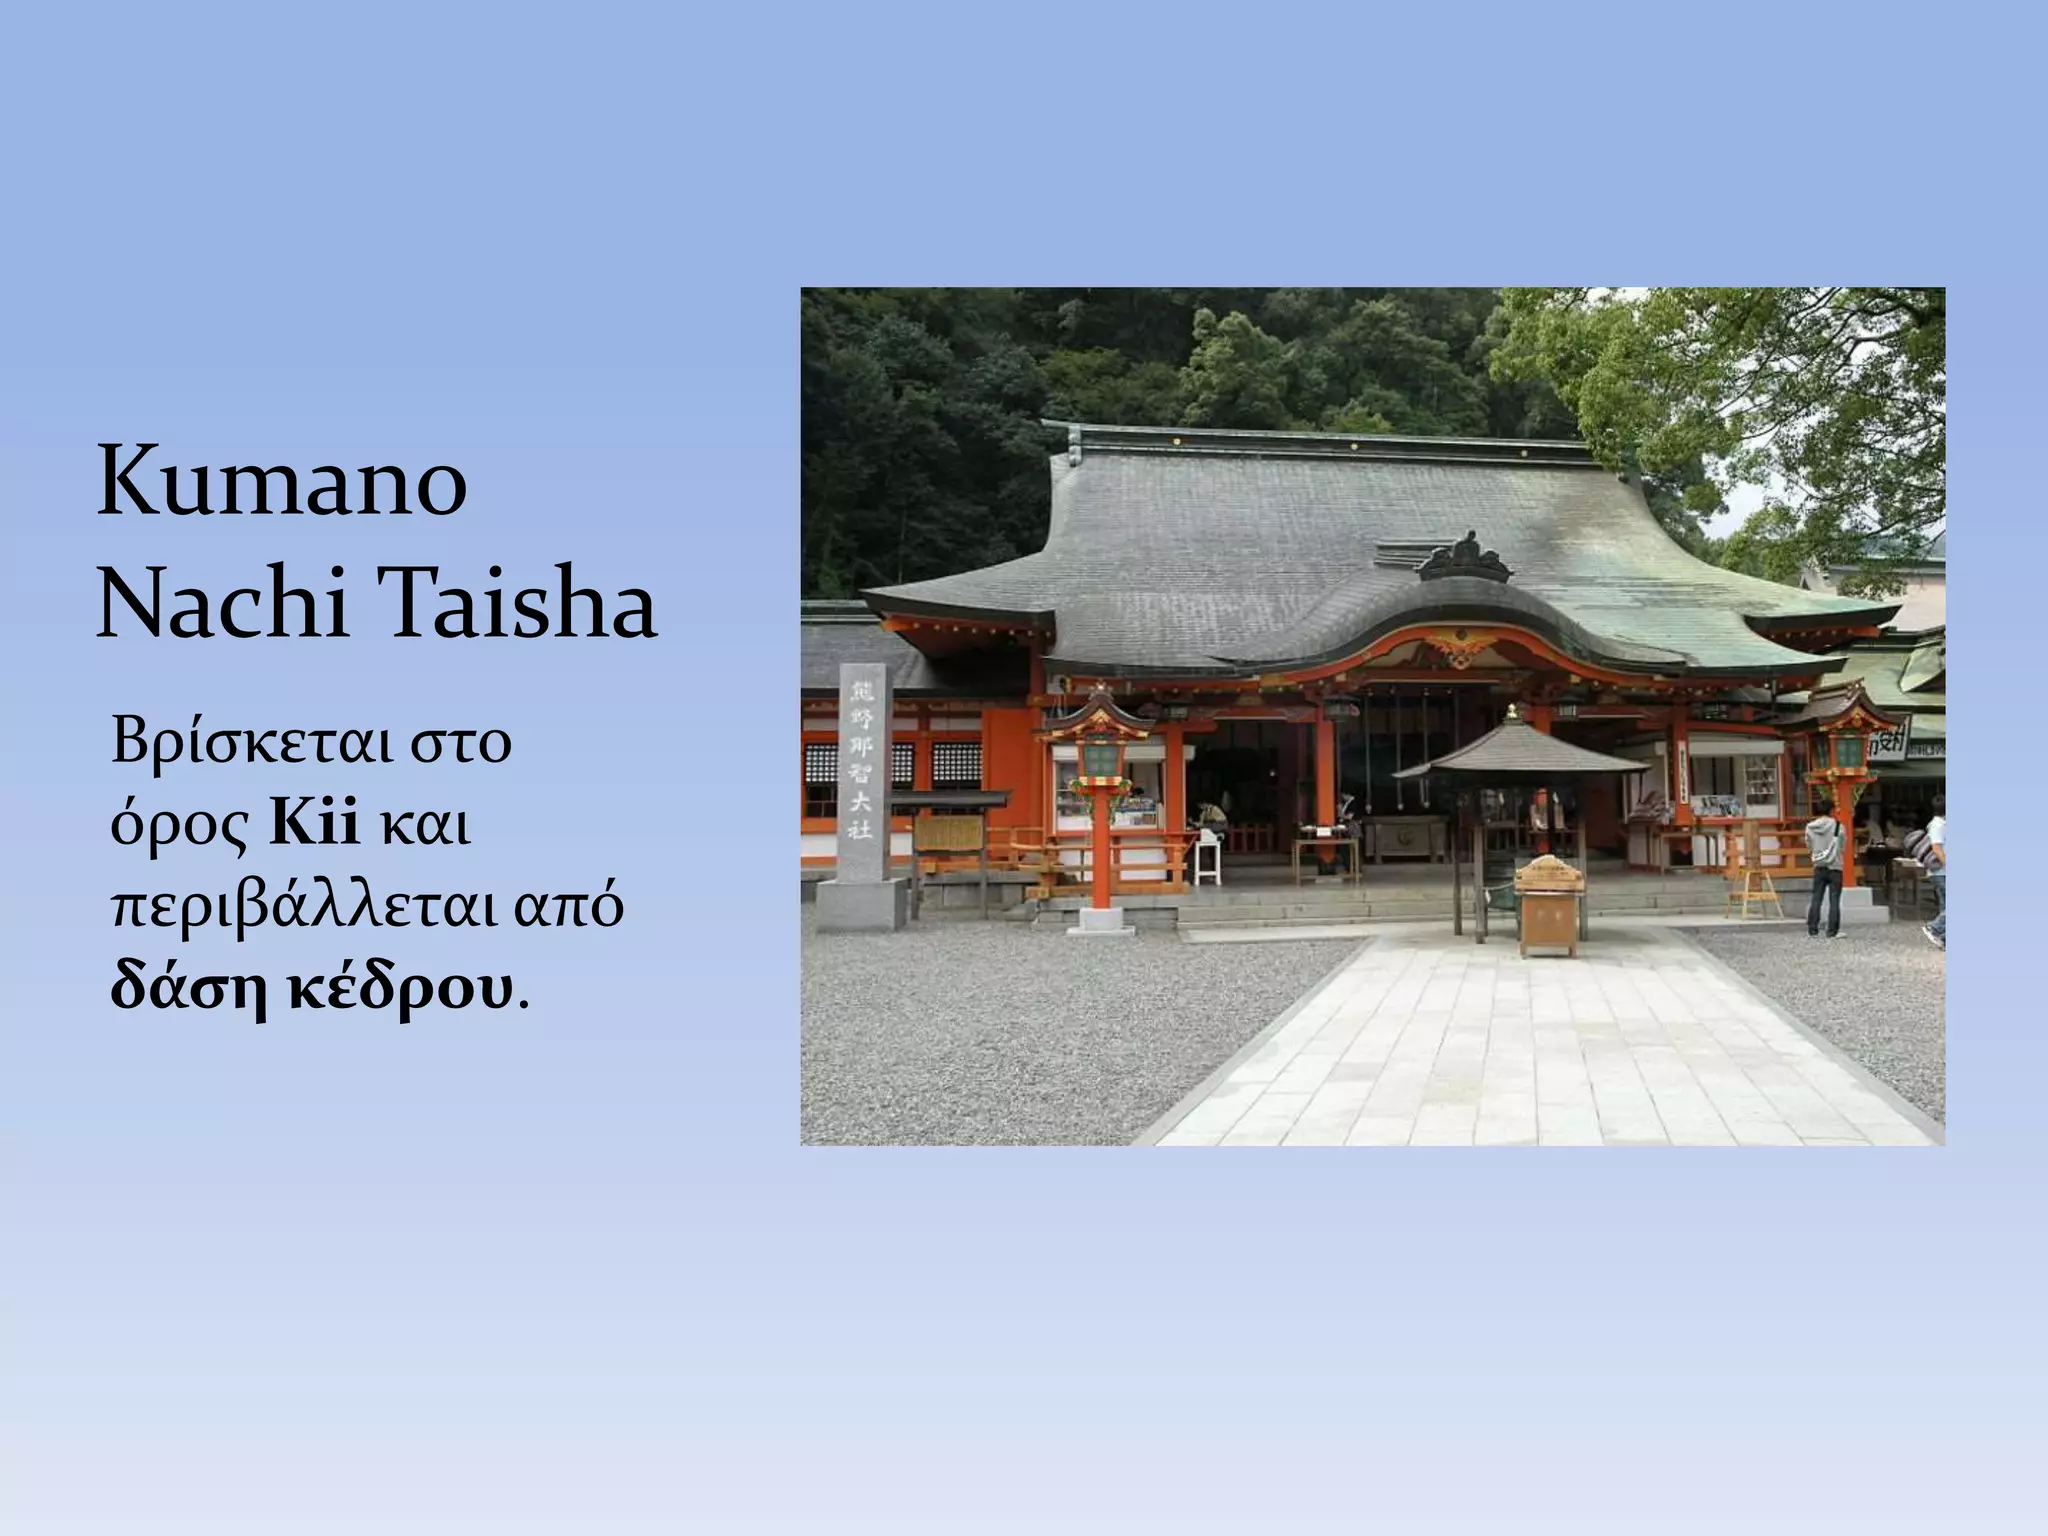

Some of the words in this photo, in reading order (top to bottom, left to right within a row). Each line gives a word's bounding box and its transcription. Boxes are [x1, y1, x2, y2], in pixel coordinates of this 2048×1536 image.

[848, 680, 875, 840] 熊野那智大社
